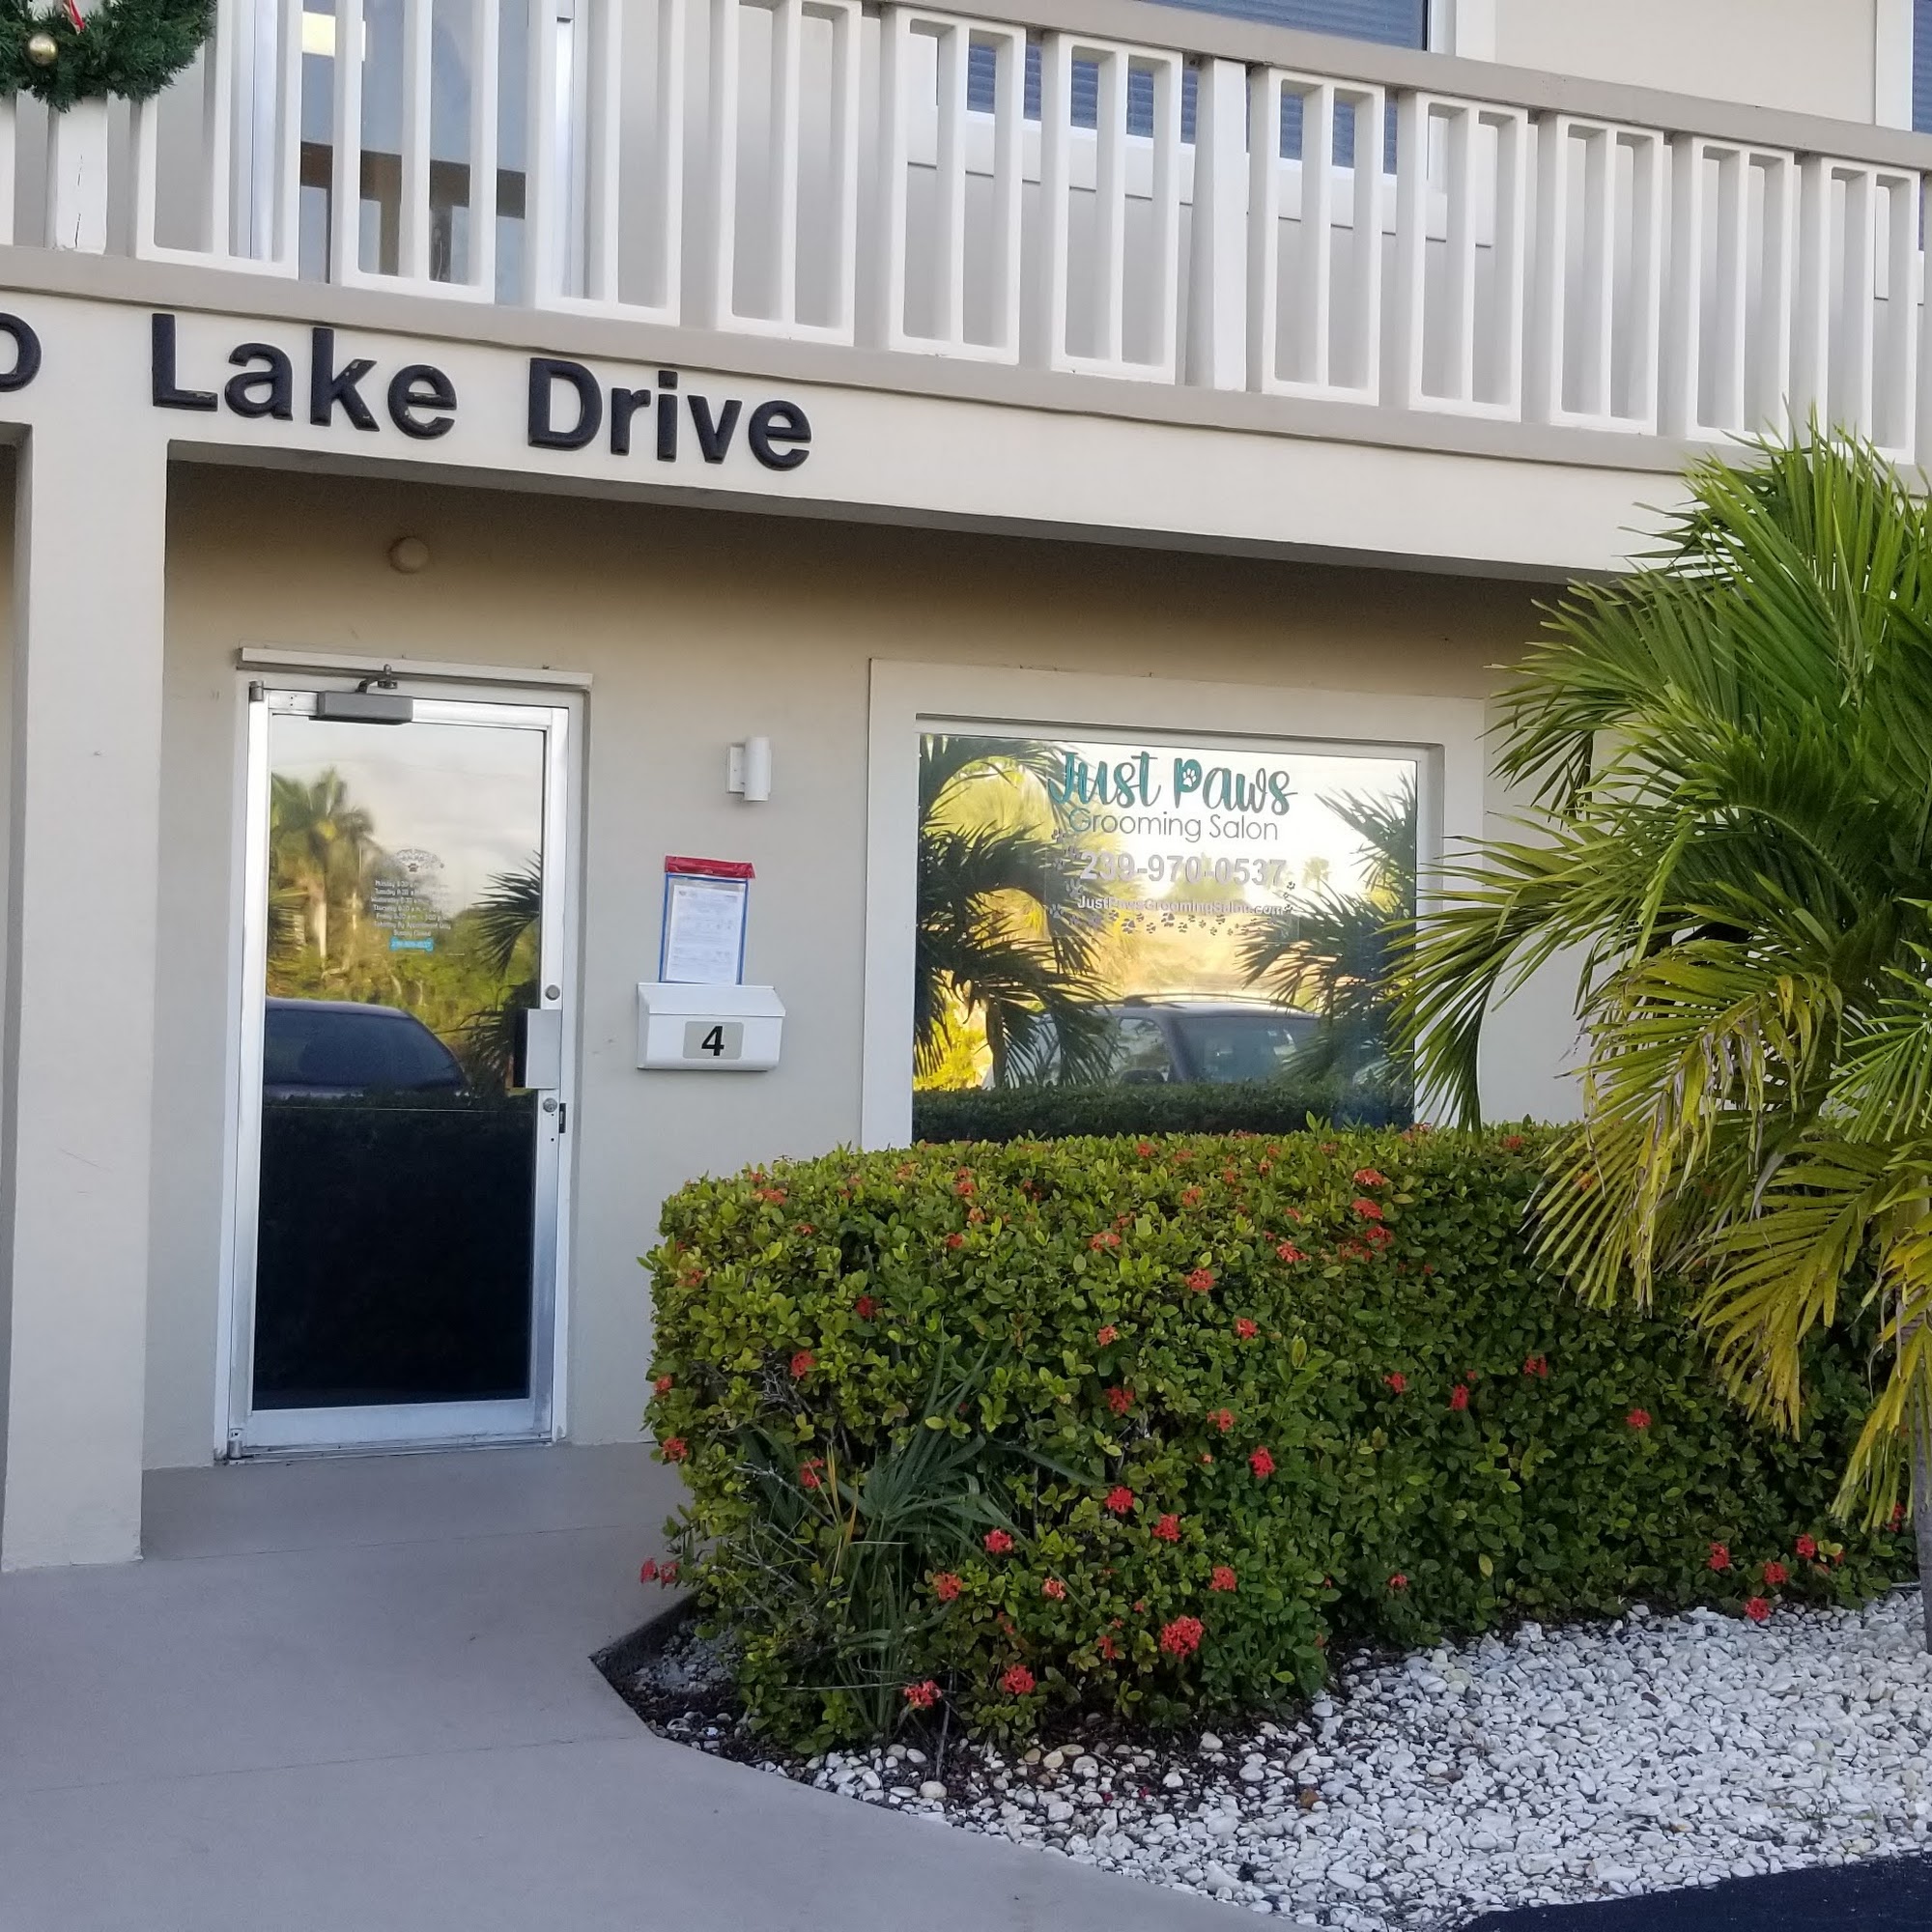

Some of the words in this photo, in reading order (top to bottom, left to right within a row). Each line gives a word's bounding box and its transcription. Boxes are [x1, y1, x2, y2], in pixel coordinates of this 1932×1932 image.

[151, 312, 457, 441] Lake
[527, 355, 812, 472] Drive
[1047, 751, 1162, 810] Just
[1174, 756, 1298, 816] Paws
[1068, 807, 1202, 843] Grooming
[1209, 813, 1279, 840] Salon
[1079, 851, 1288, 886] 239-970-0537
[701, 1025, 724, 1057] 4
